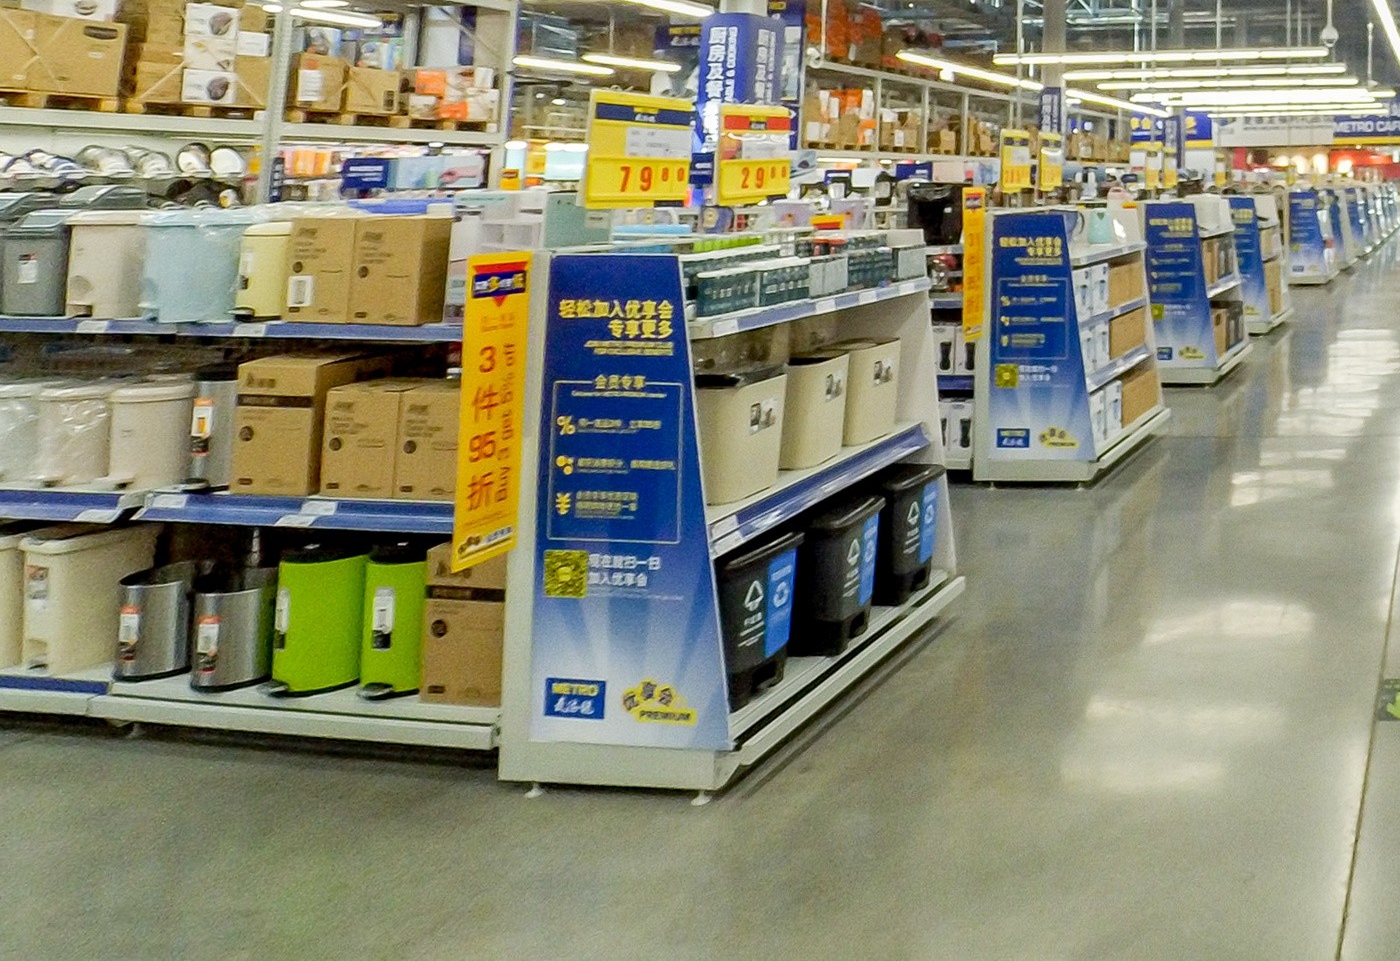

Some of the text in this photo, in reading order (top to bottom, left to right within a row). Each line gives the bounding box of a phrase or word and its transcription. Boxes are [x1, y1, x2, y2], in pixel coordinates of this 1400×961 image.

[1334, 121, 1374, 133] METRO
[559, 299, 674, 319] 轻松加入优享会
[608, 319, 674, 339] 专享更多
